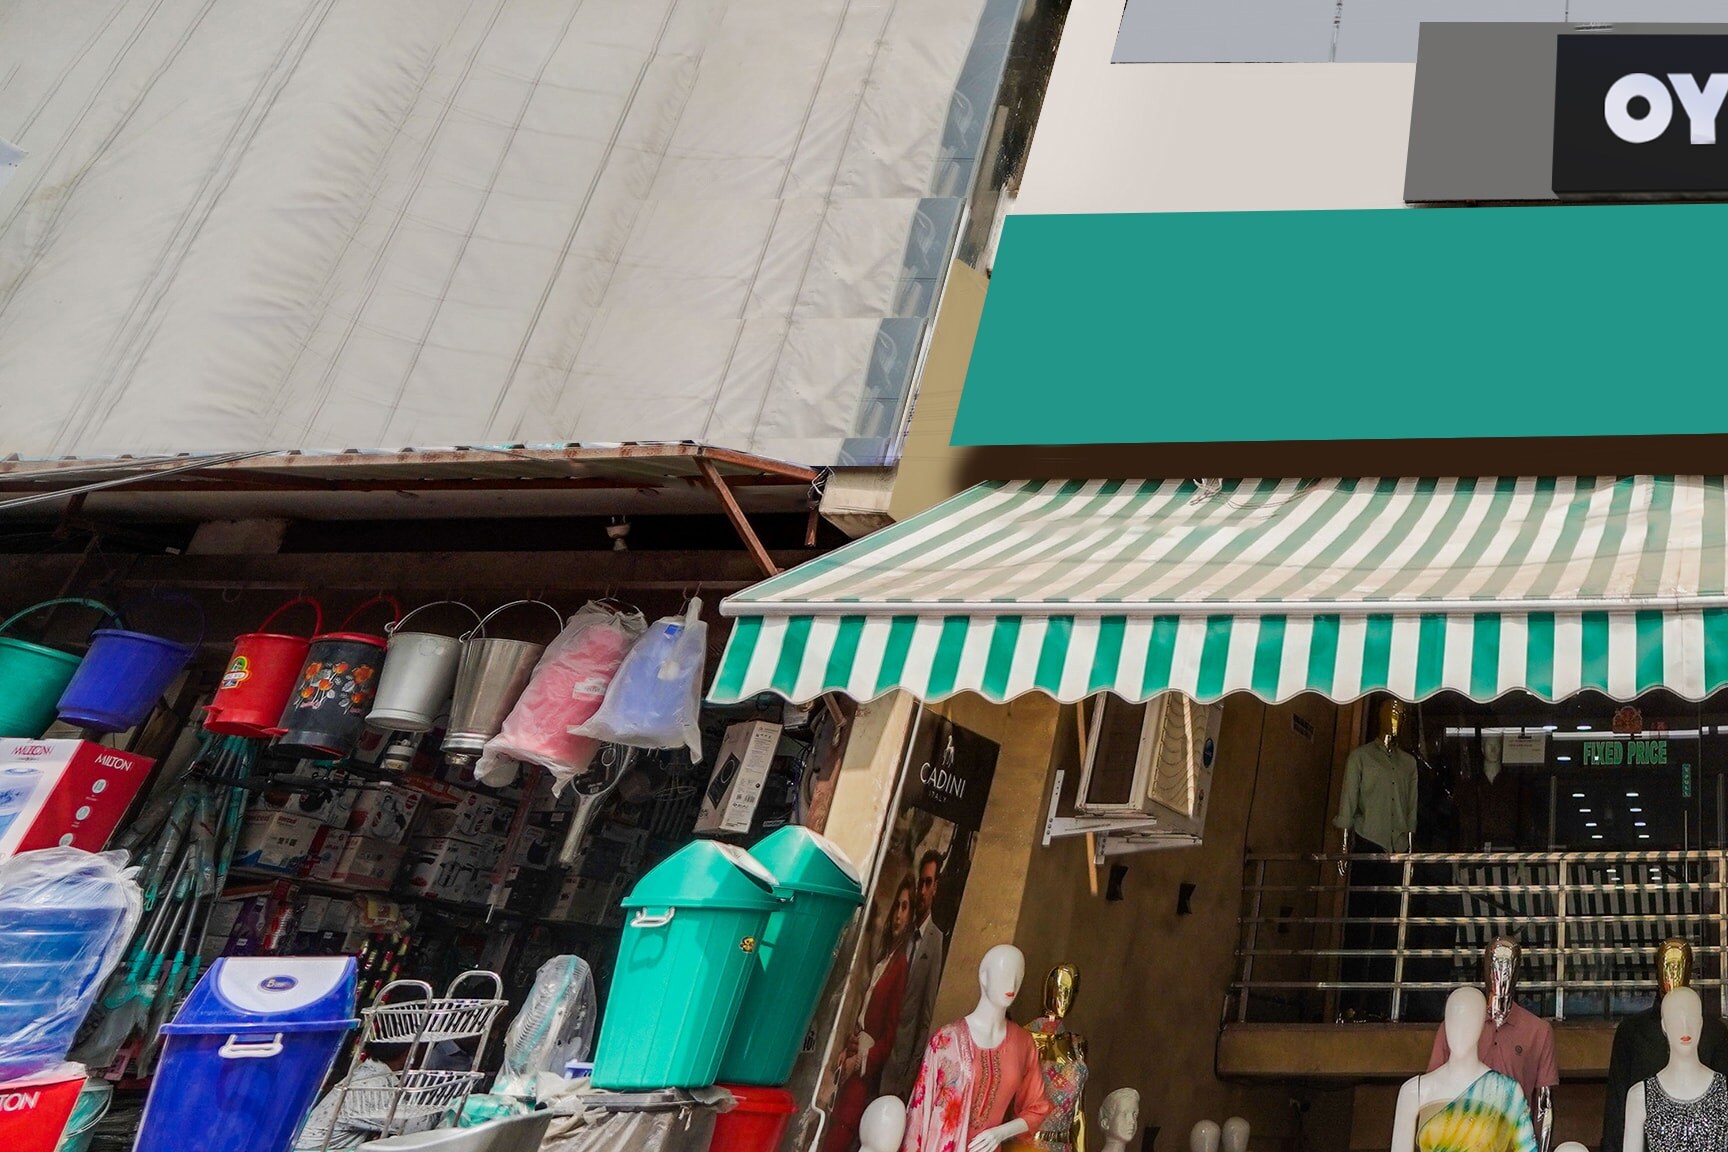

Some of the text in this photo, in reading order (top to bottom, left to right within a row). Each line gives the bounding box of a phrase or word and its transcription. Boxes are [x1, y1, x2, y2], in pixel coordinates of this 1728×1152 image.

[94, 753, 134, 772] MILTON
[1583, 740, 1668, 765] FIXED PRICE
[920, 762, 966, 799] CADINI
[0, 1091, 42, 1112] TON
